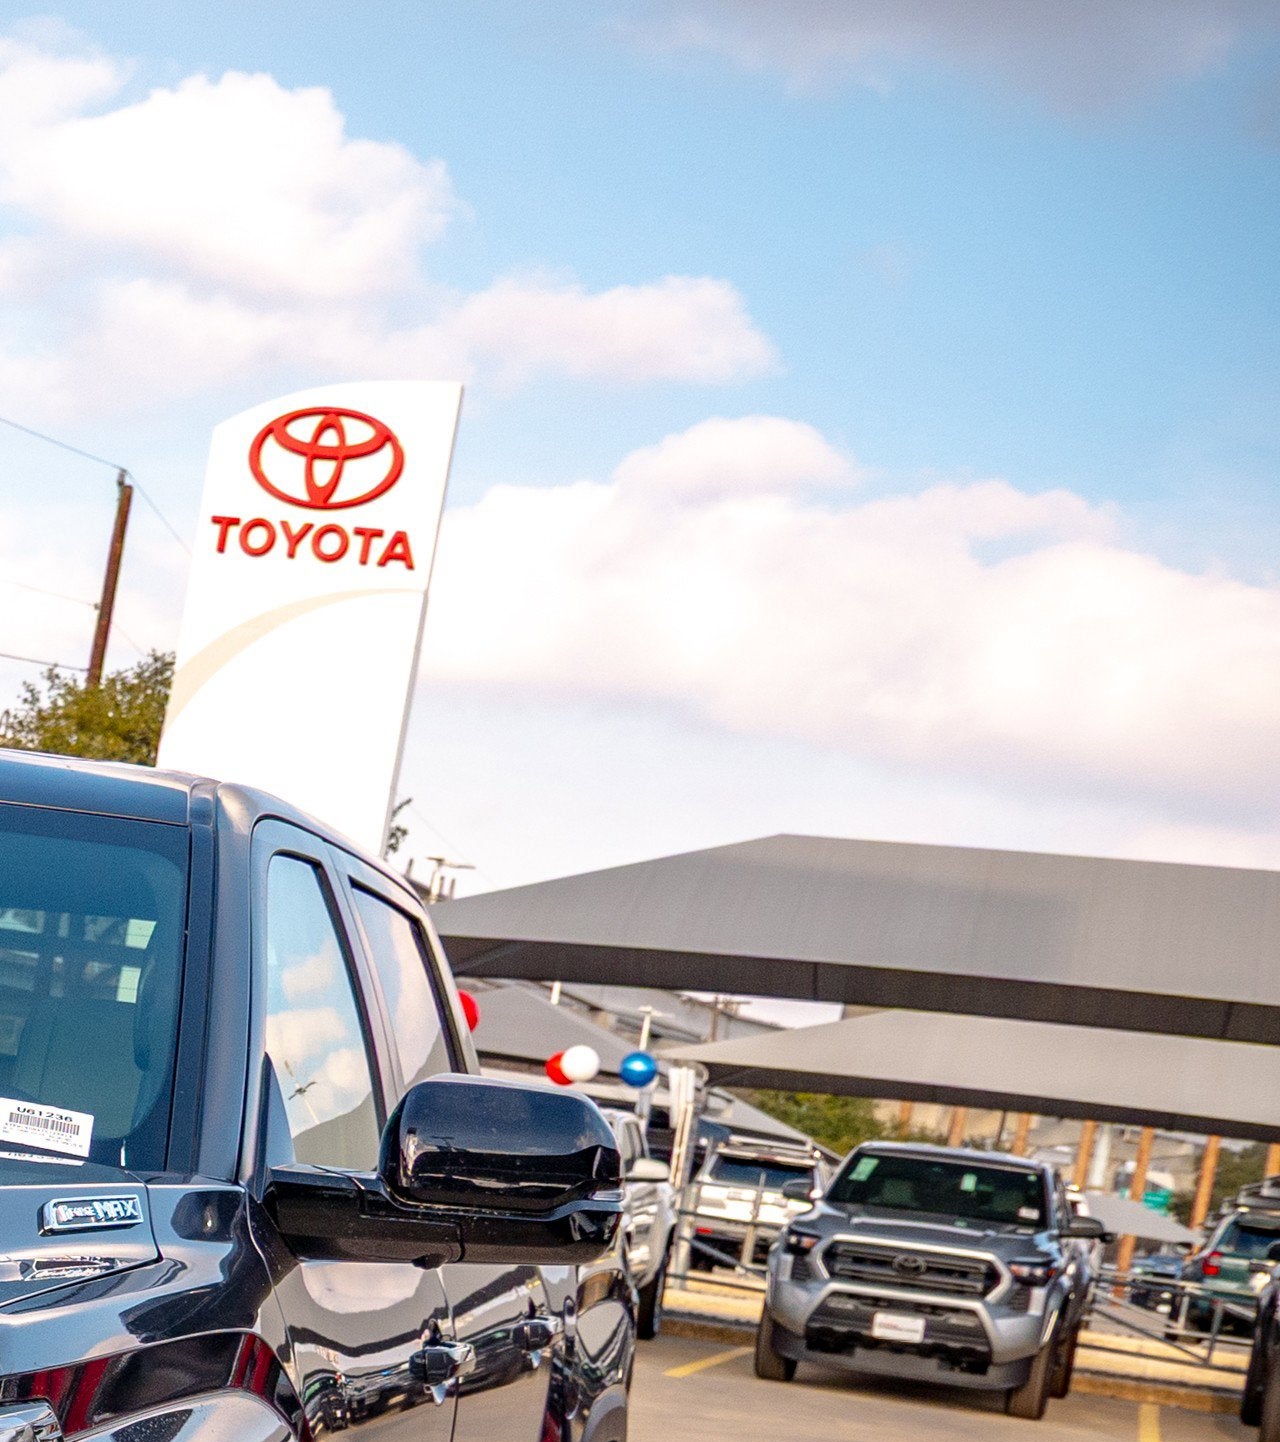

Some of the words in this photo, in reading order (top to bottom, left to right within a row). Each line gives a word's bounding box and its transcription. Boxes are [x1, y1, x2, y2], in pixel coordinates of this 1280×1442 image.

[210, 515, 415, 570] TOYOTA
[16, 1106, 73, 1123] U61236
[92, 1199, 139, 1221] MAX
